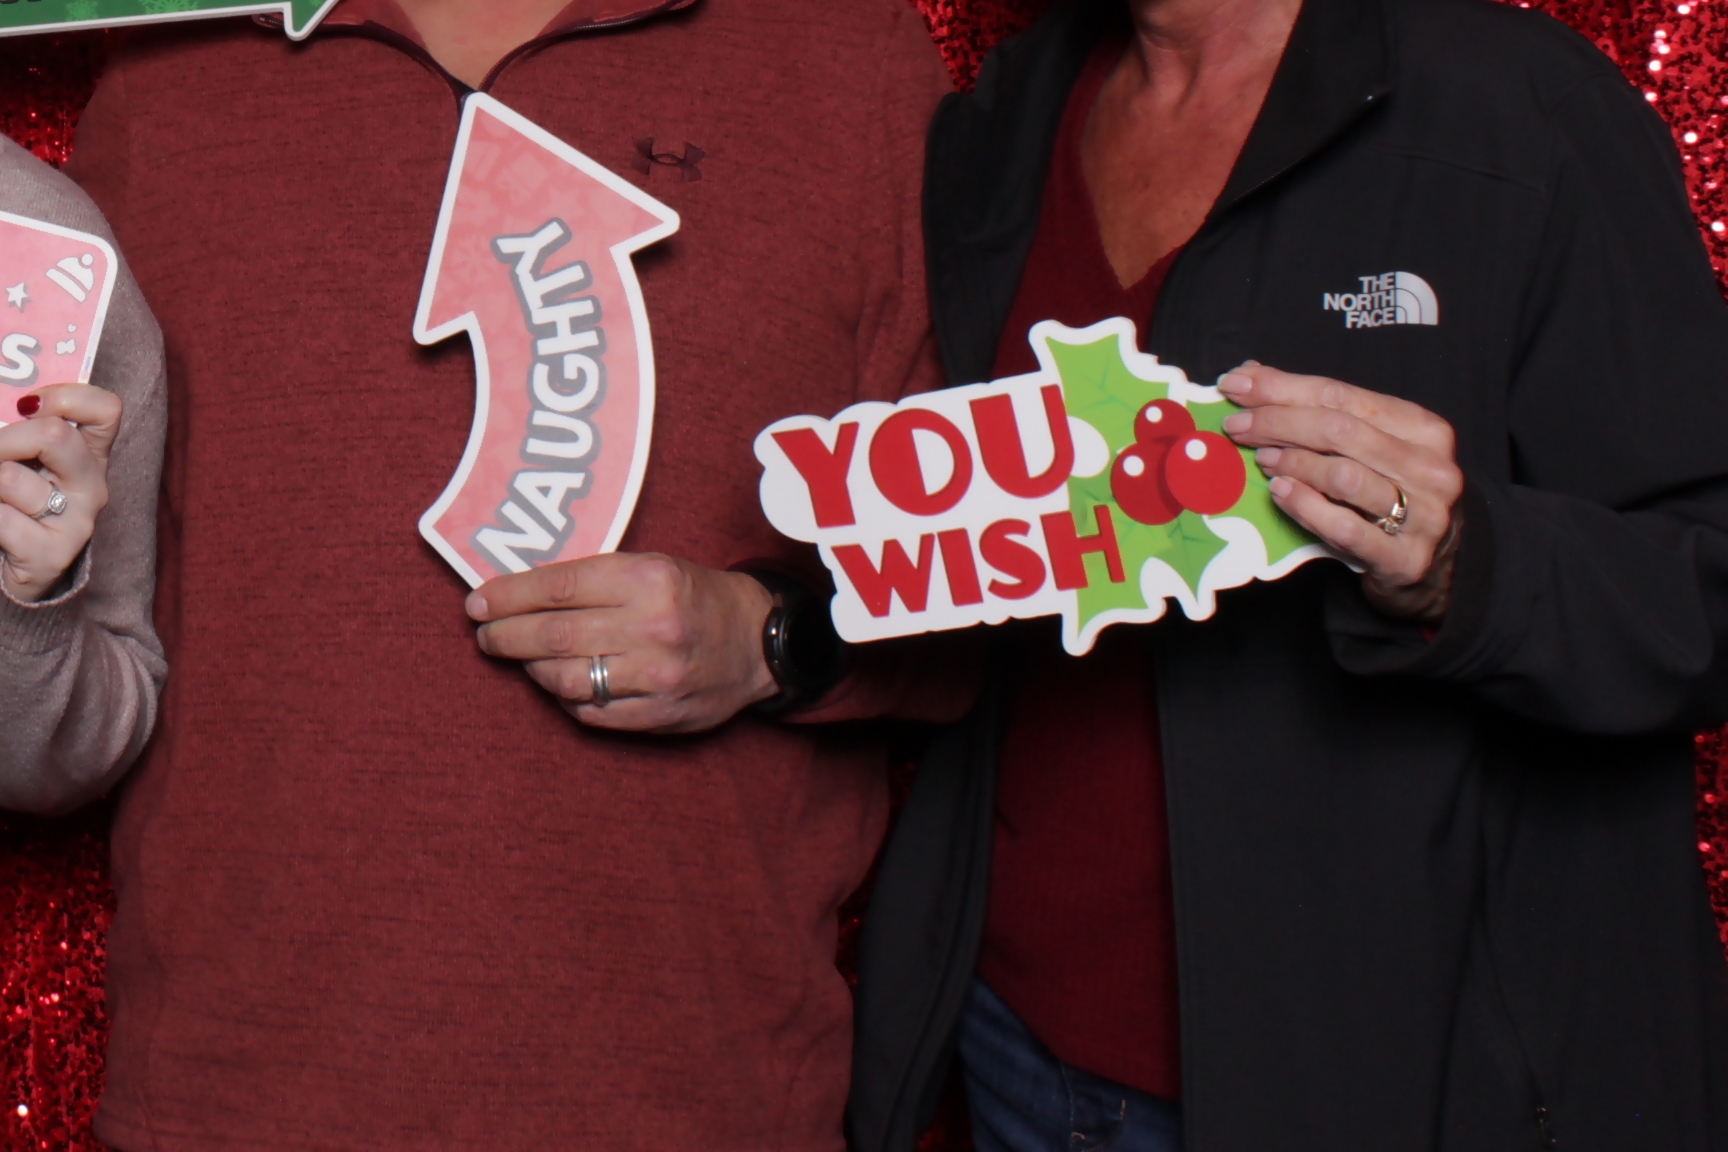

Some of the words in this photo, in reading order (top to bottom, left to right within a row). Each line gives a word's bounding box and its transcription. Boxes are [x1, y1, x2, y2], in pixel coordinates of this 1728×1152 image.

[1323, 289, 1395, 311] NORTH
[1358, 272, 1395, 293] THE
[1345, 307, 1395, 328] FACE
[474, 219, 603, 574] NAUGHTY
[770, 384, 1075, 529] YOU
[830, 504, 1126, 618] WISH
